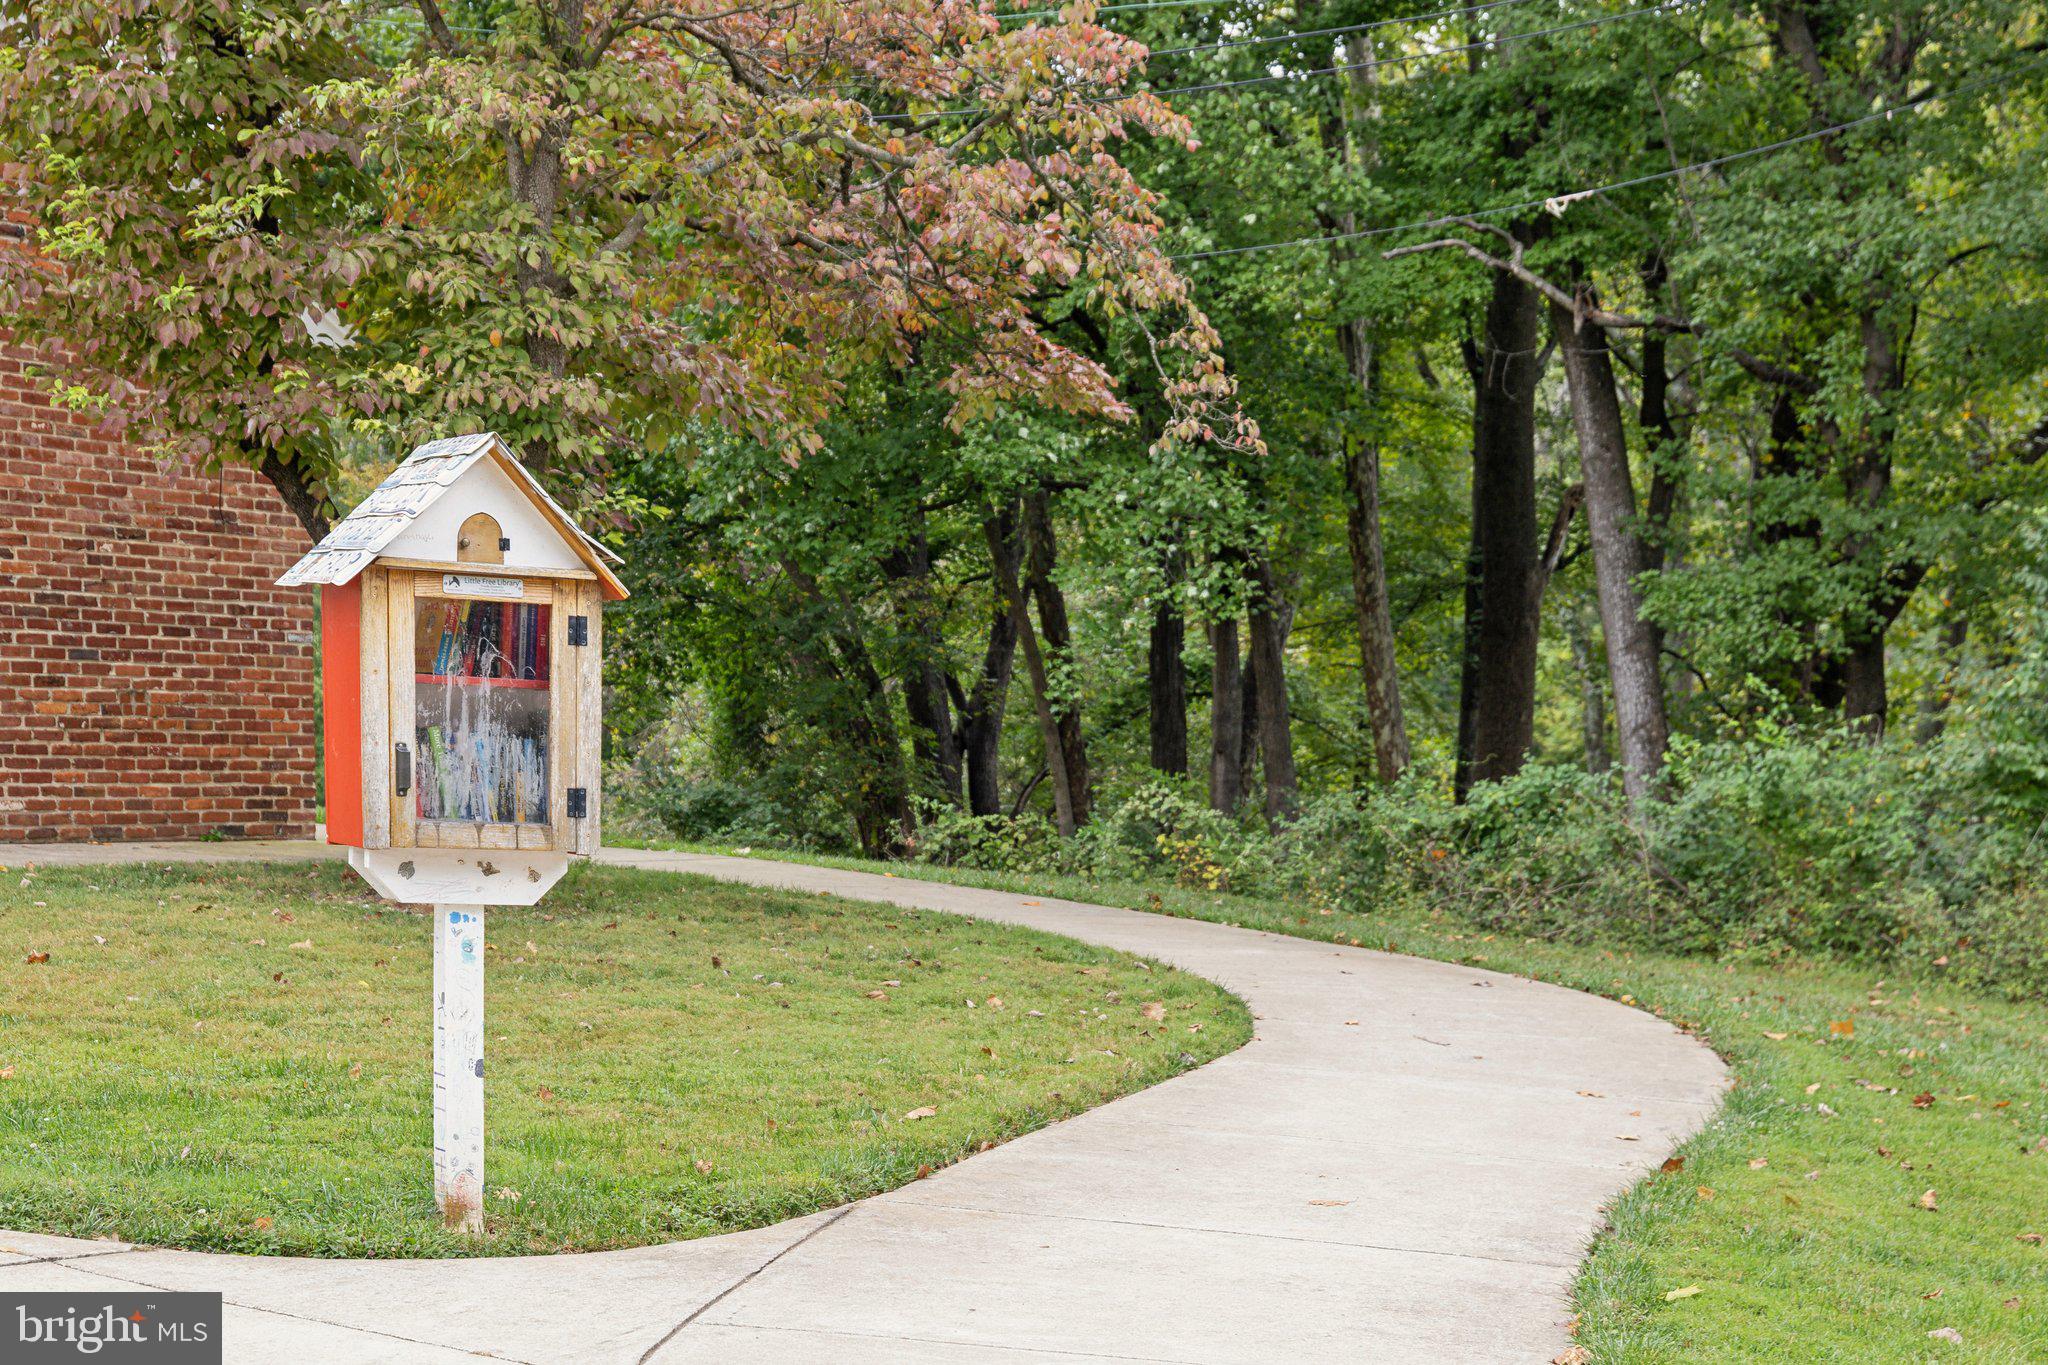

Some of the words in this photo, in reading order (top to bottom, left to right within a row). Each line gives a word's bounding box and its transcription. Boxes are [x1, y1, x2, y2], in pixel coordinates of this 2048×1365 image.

[464, 576, 481, 585] Little
[482, 578, 496, 586] Free
[497, 579, 520, 588] Library
[433, 729, 441, 749] More
